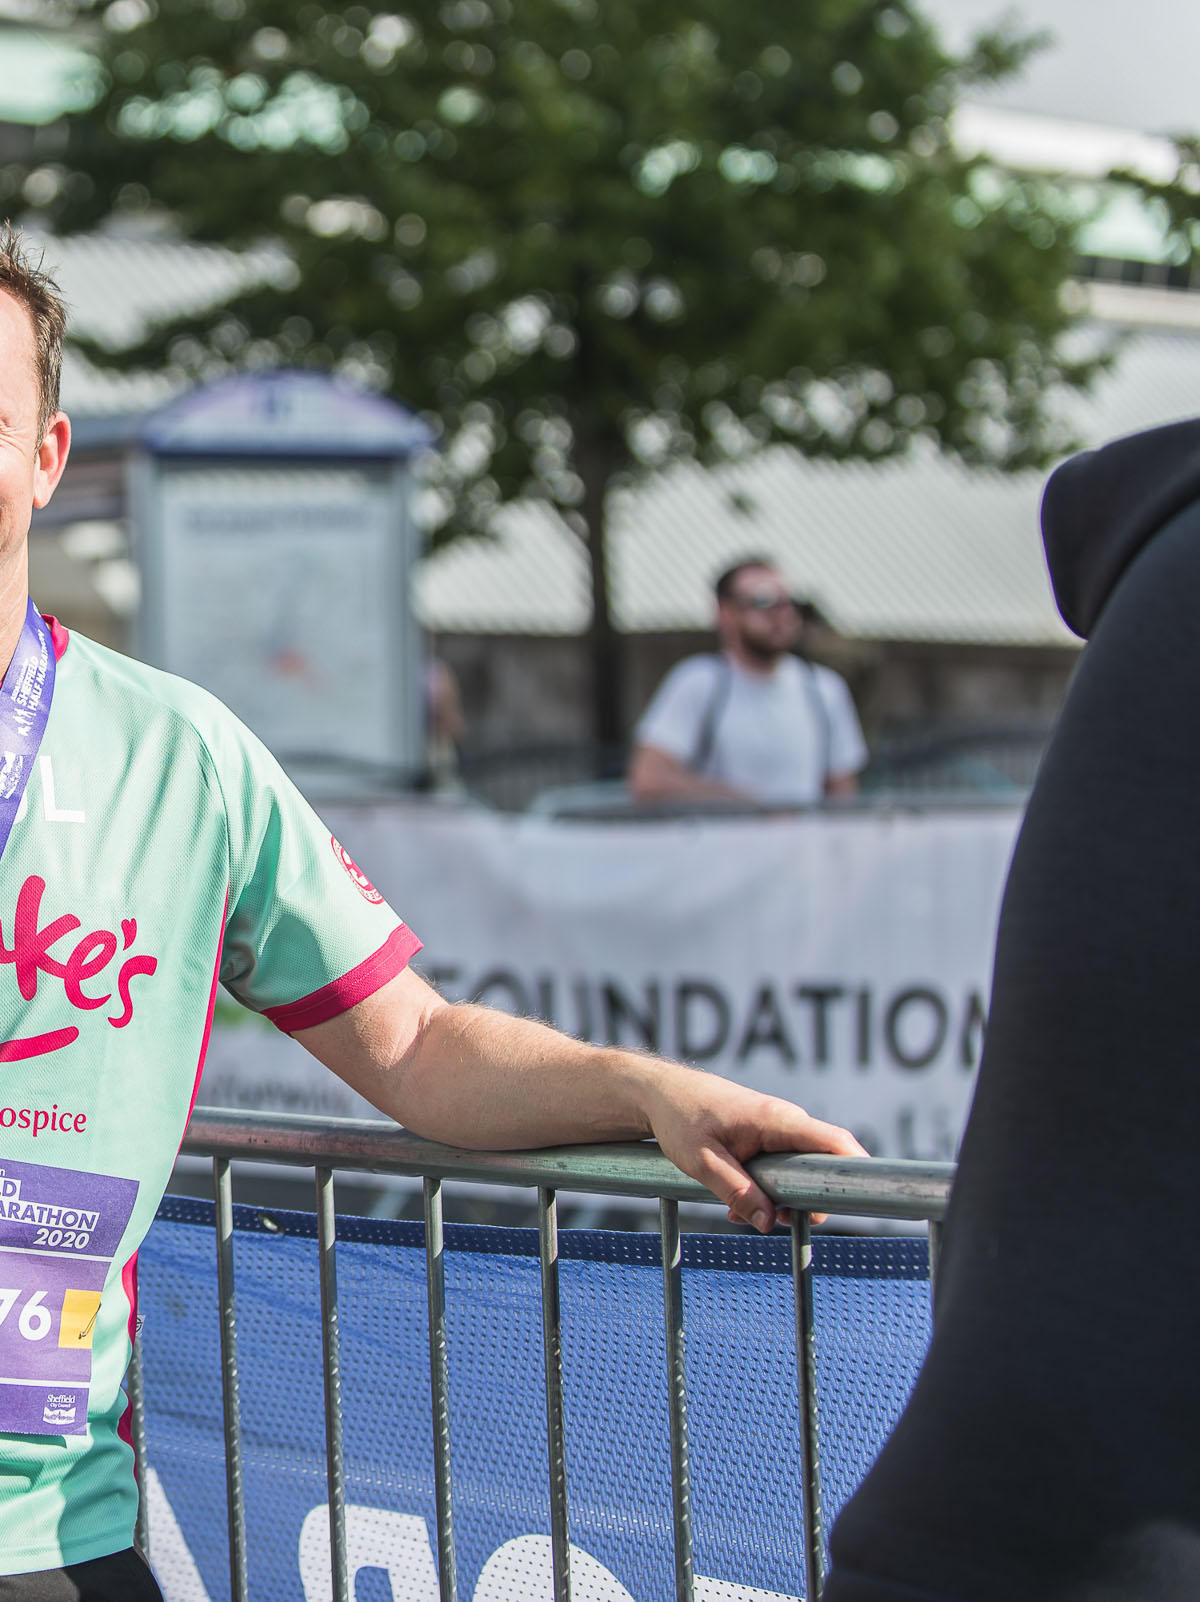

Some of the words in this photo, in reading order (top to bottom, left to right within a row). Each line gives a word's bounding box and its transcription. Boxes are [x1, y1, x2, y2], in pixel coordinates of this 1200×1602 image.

[16, 655, 38, 706] SHEFFIELD
[28, 686, 42, 712] HALF
[33, 1228, 90, 1250] 2020
[47, 1394, 75, 1404] Sheffield
